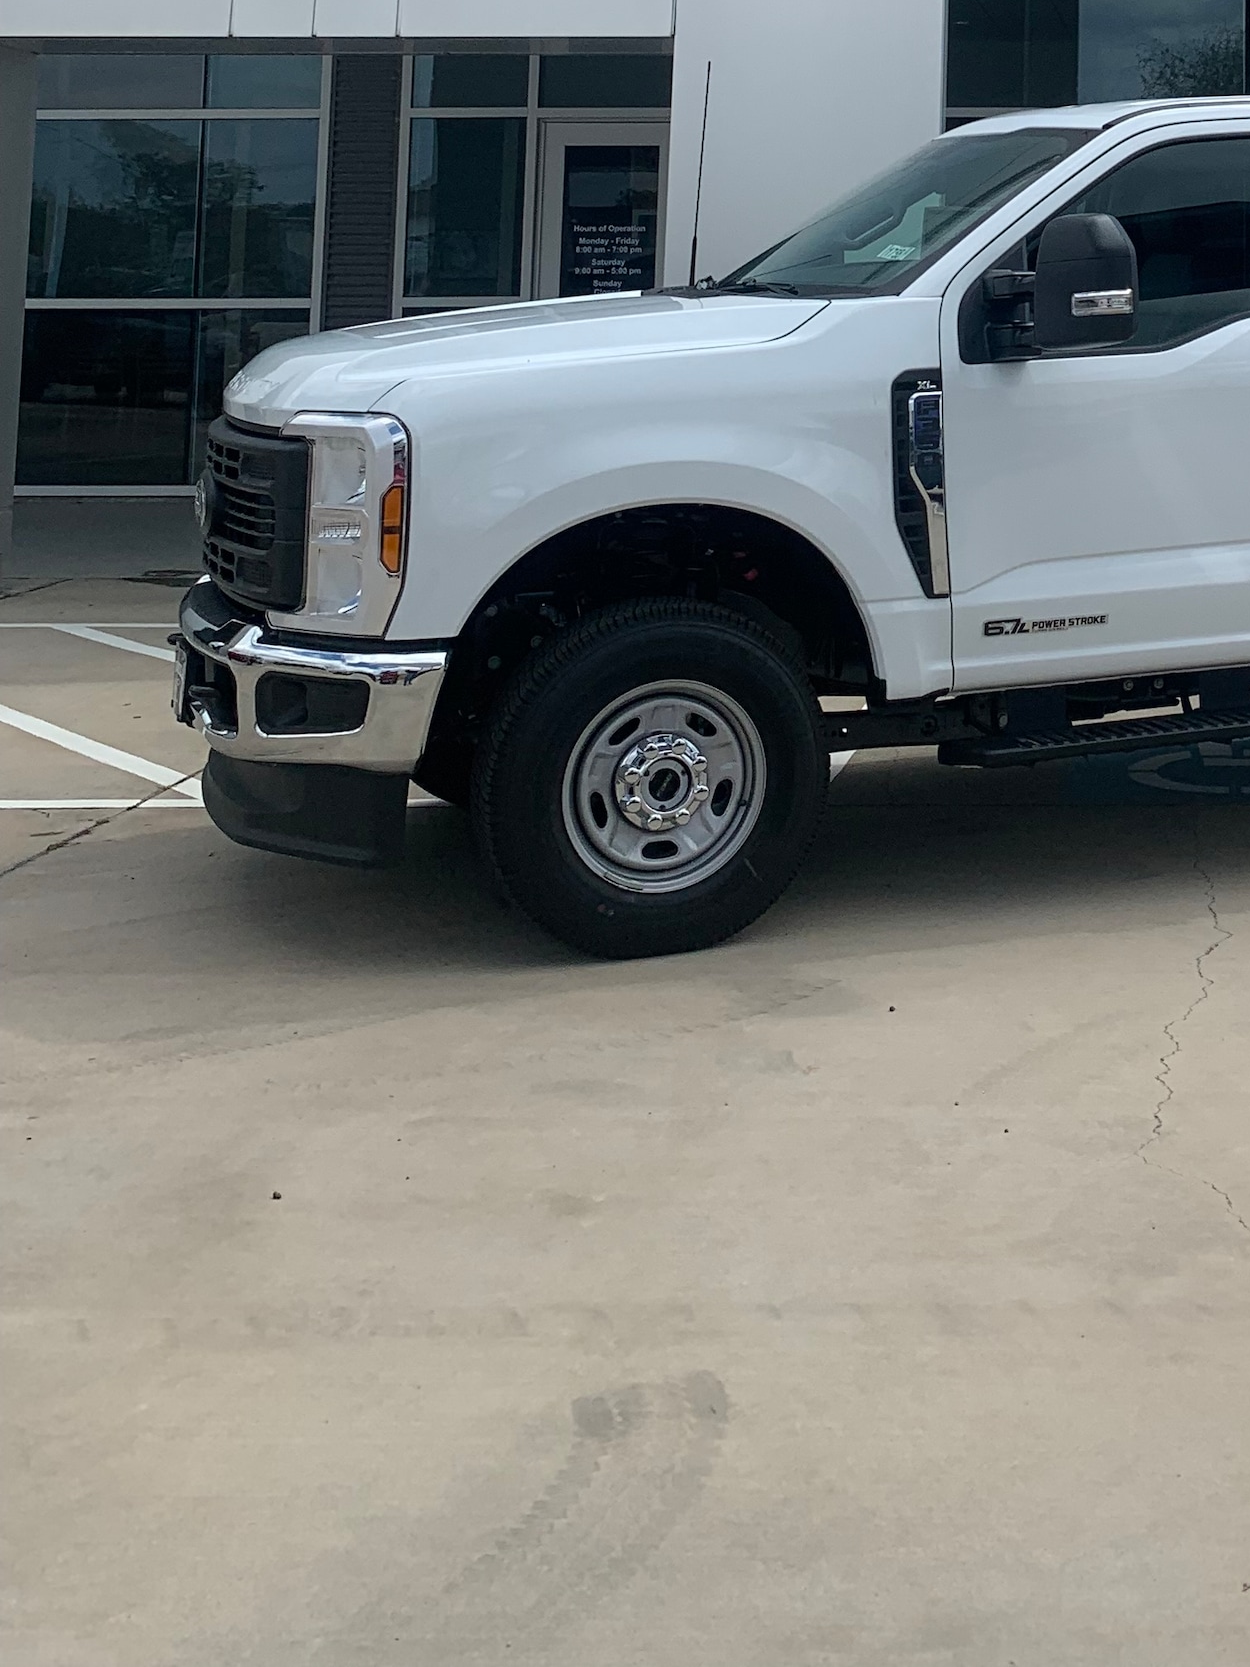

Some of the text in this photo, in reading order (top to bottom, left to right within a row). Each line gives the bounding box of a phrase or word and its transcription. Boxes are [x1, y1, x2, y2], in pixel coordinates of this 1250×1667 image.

[573, 224, 646, 233] Hours of Operation
[579, 237, 609, 246] Monday
[615, 237, 640, 245] Friday
[591, 258, 625, 266] Saturday
[593, 280, 622, 288] Sunday
[917, 380, 937, 390] XL
[984, 618, 1030, 636] 6.7L
[1031, 619, 1066, 629] POWER
[1068, 615, 1107, 626] STROKE
